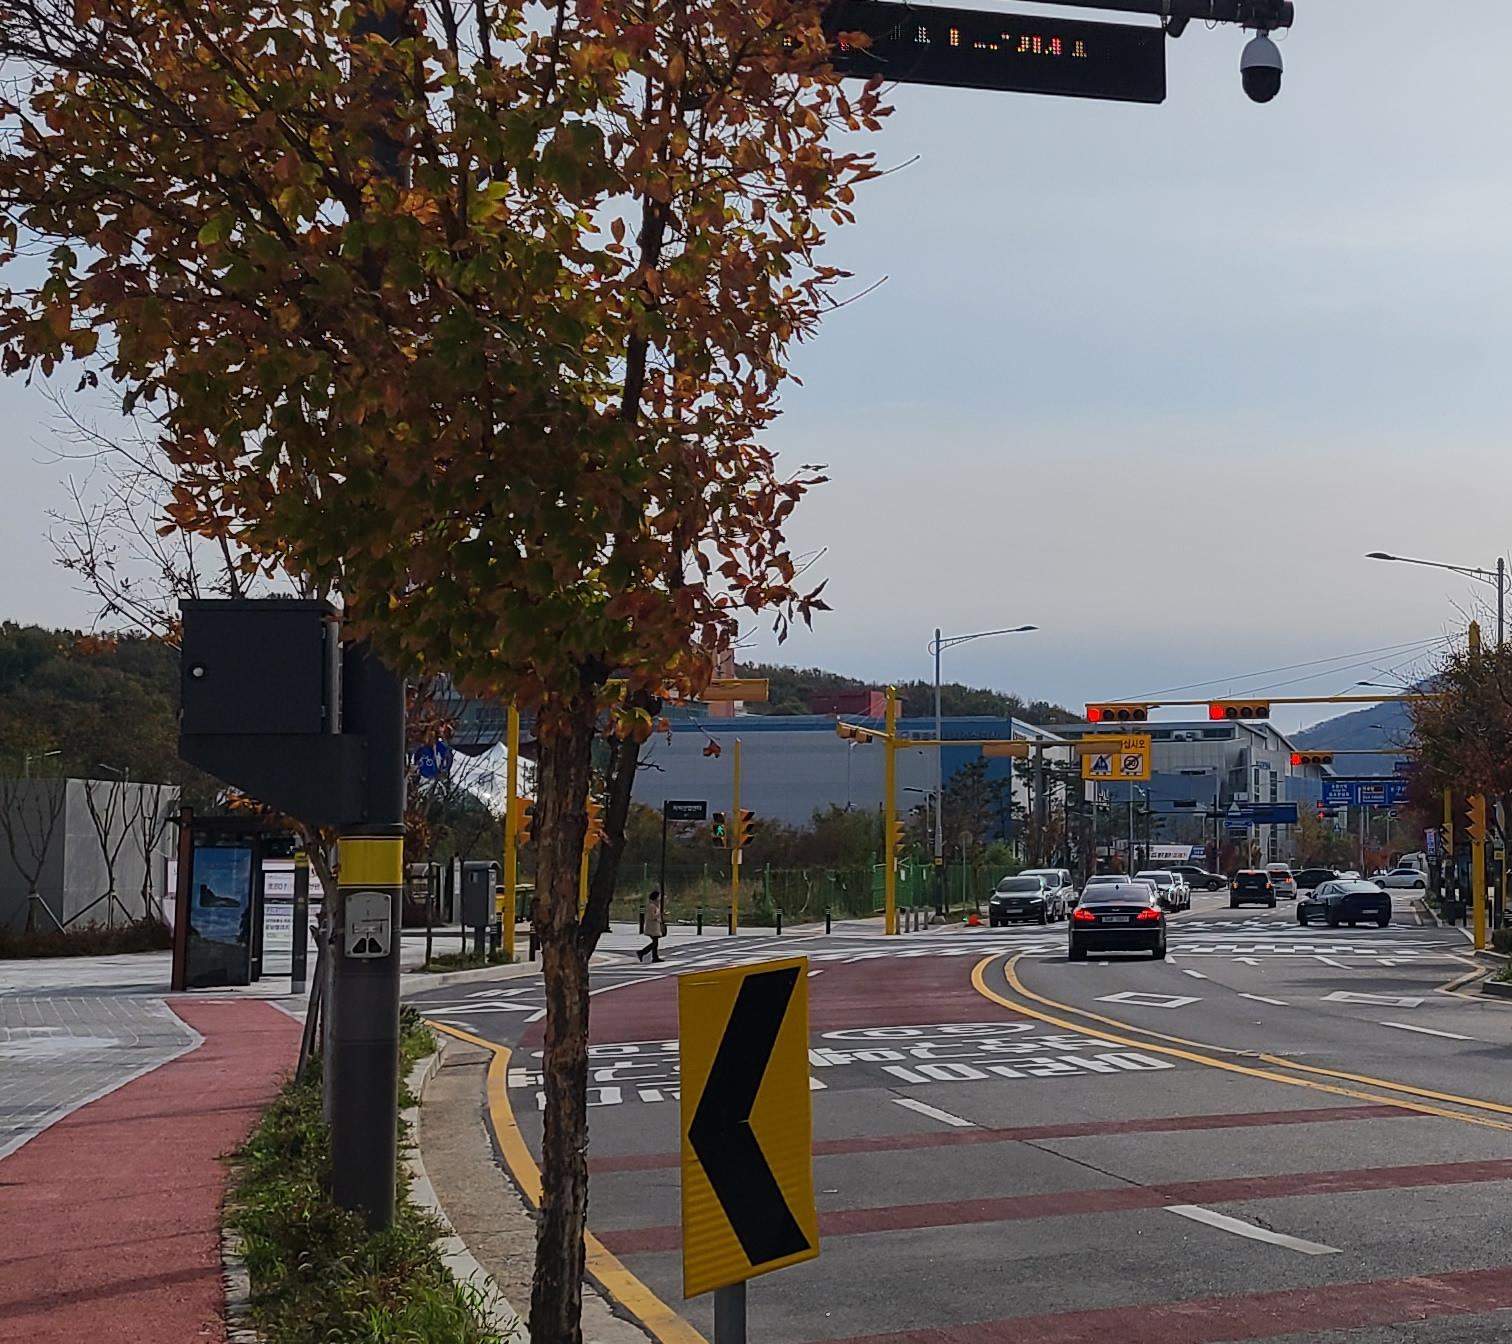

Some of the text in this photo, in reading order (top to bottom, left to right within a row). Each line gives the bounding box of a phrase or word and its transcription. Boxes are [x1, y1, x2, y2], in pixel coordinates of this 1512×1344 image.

[862, 1024, 998, 1037] 30
[811, 1034, 1127, 1066] 보호구역
[879, 1052, 1176, 1084] 어린이
